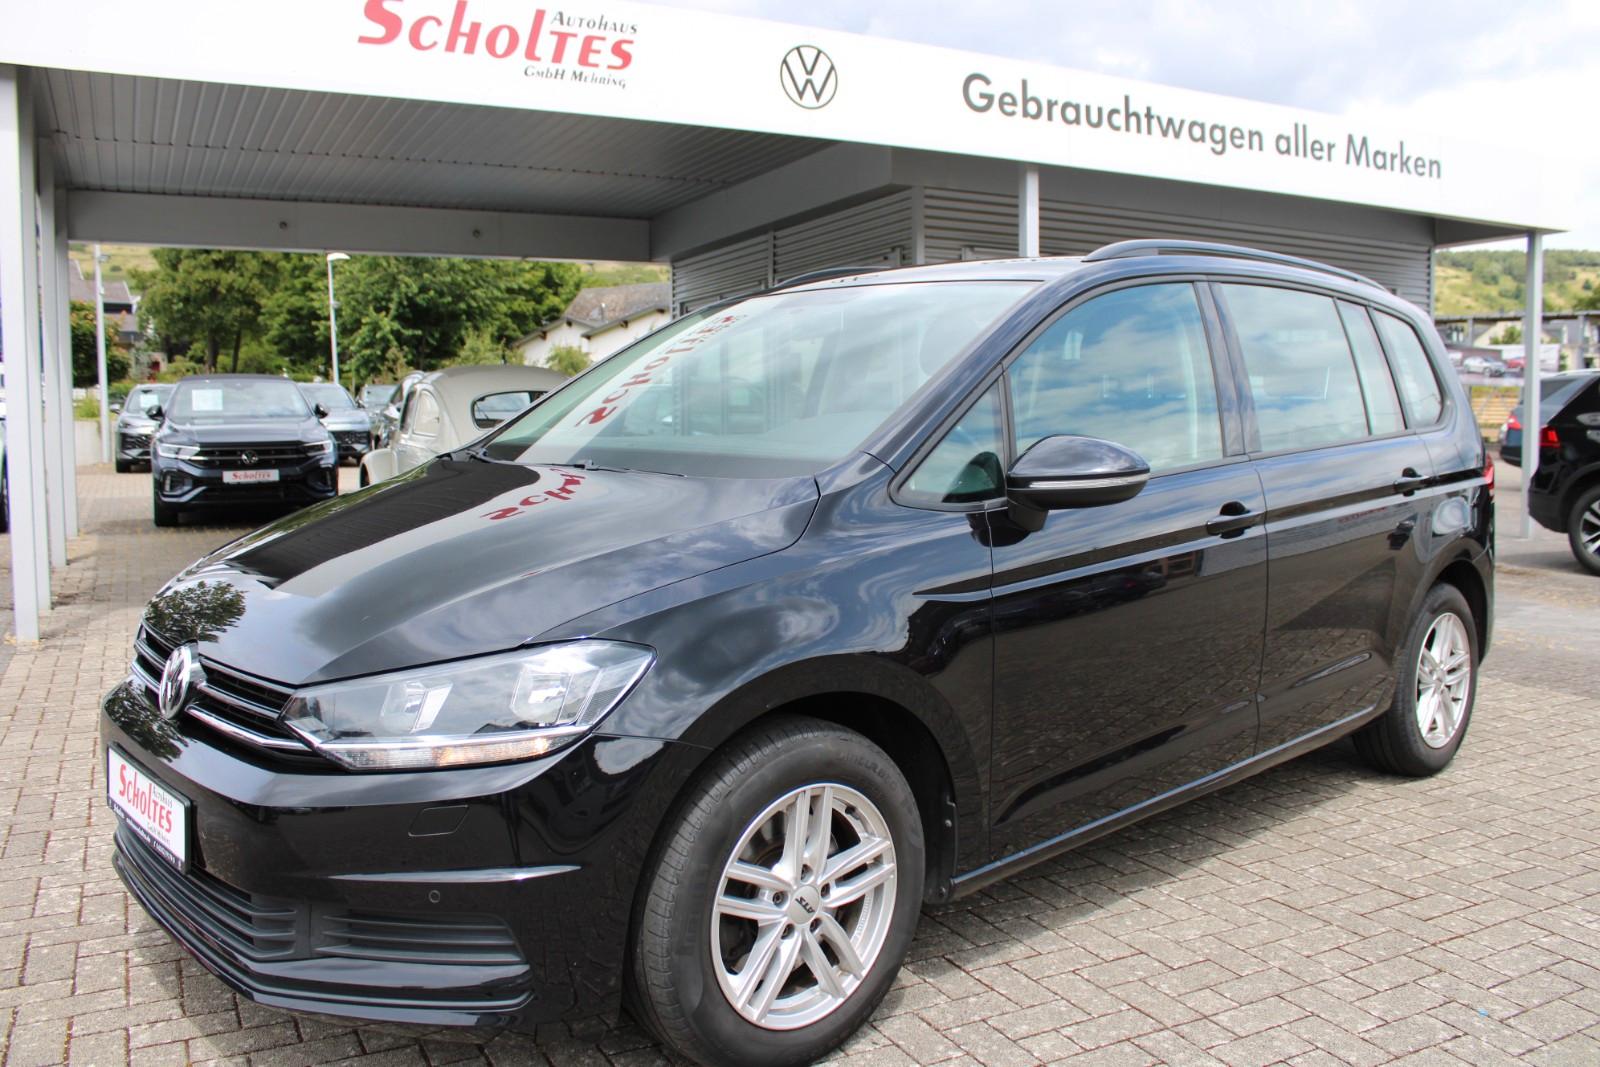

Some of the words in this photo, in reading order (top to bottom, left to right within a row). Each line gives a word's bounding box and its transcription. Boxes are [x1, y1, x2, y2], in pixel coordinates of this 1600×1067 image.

[962, 72, 1264, 156] Gebrauchtwagen
[1275, 122, 1336, 162] aller
[1345, 133, 1442, 179] Marken
